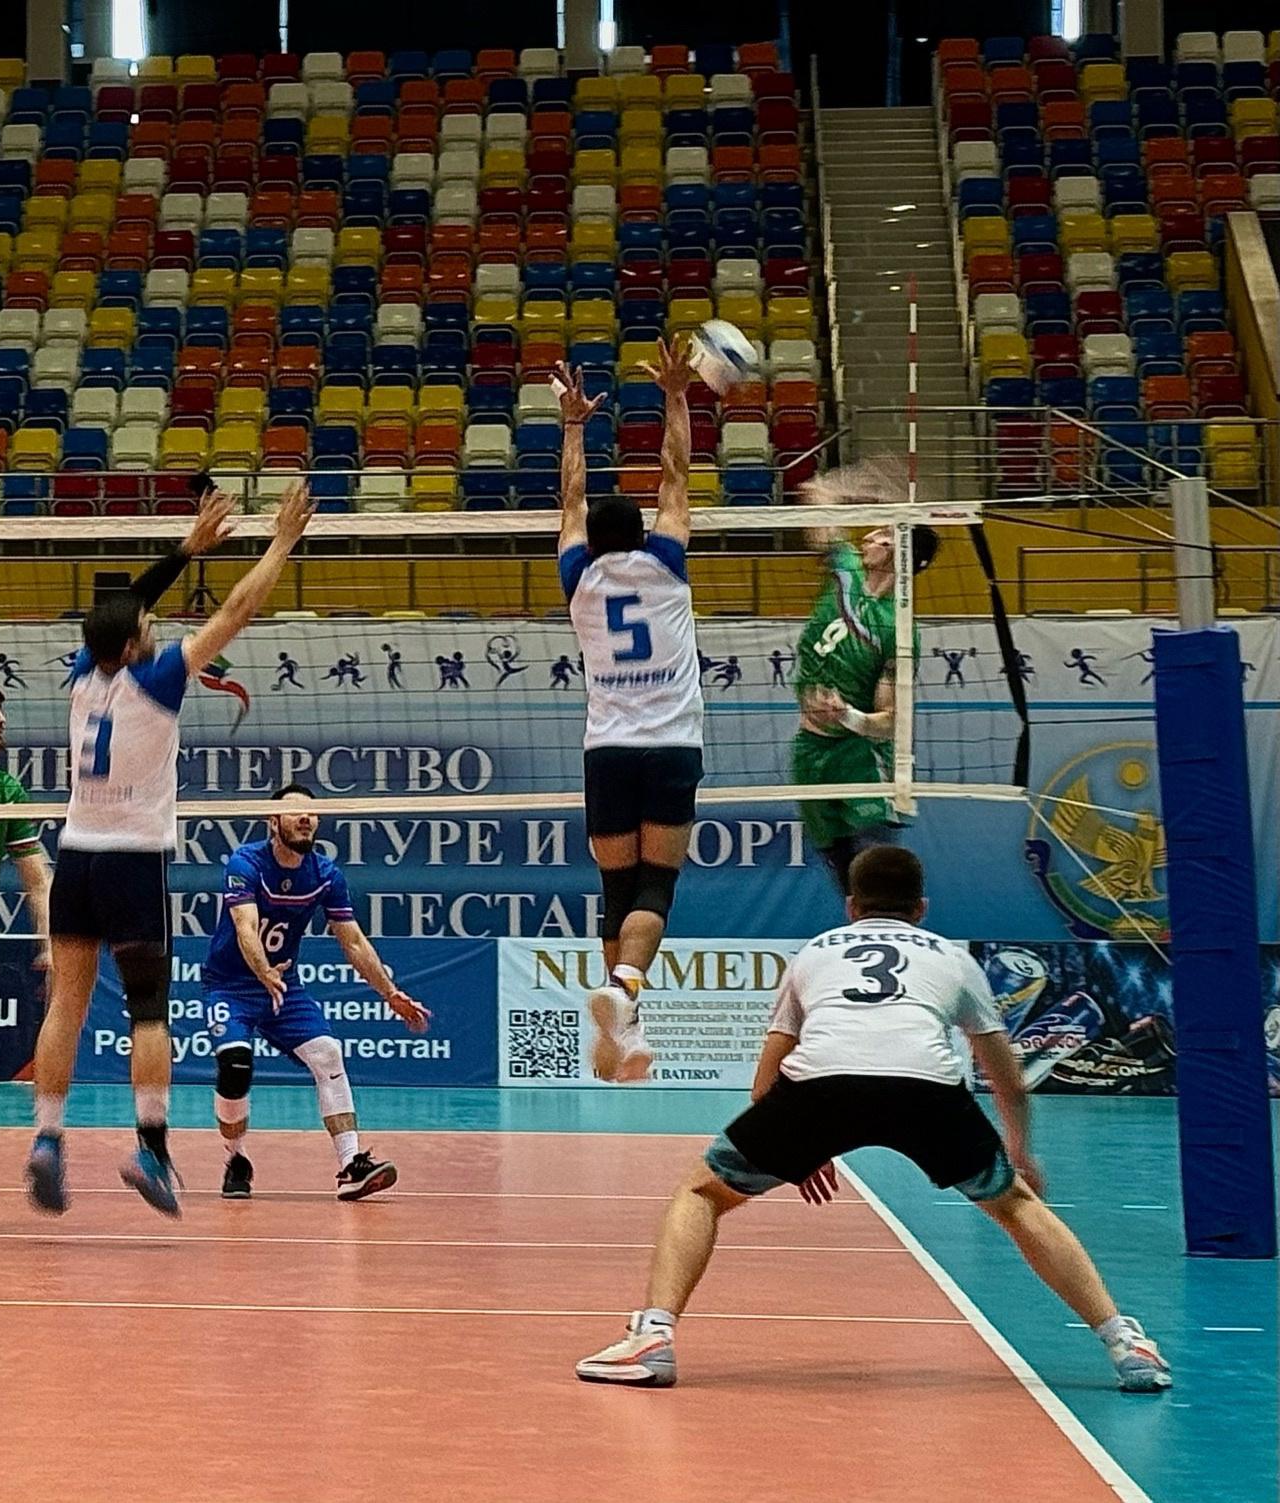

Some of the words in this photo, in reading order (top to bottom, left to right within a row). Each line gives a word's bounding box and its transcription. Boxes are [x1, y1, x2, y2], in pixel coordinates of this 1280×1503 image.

[605, 593, 652, 663] 5
[170, 819, 503, 866] КУТУРЕ
[521, 819, 571, 866] И
[259, 918, 289, 953] 16
[530, 949, 800, 991] NUMED
[842, 944, 906, 1004] 3
[338, 1038, 451, 1059] гестан
